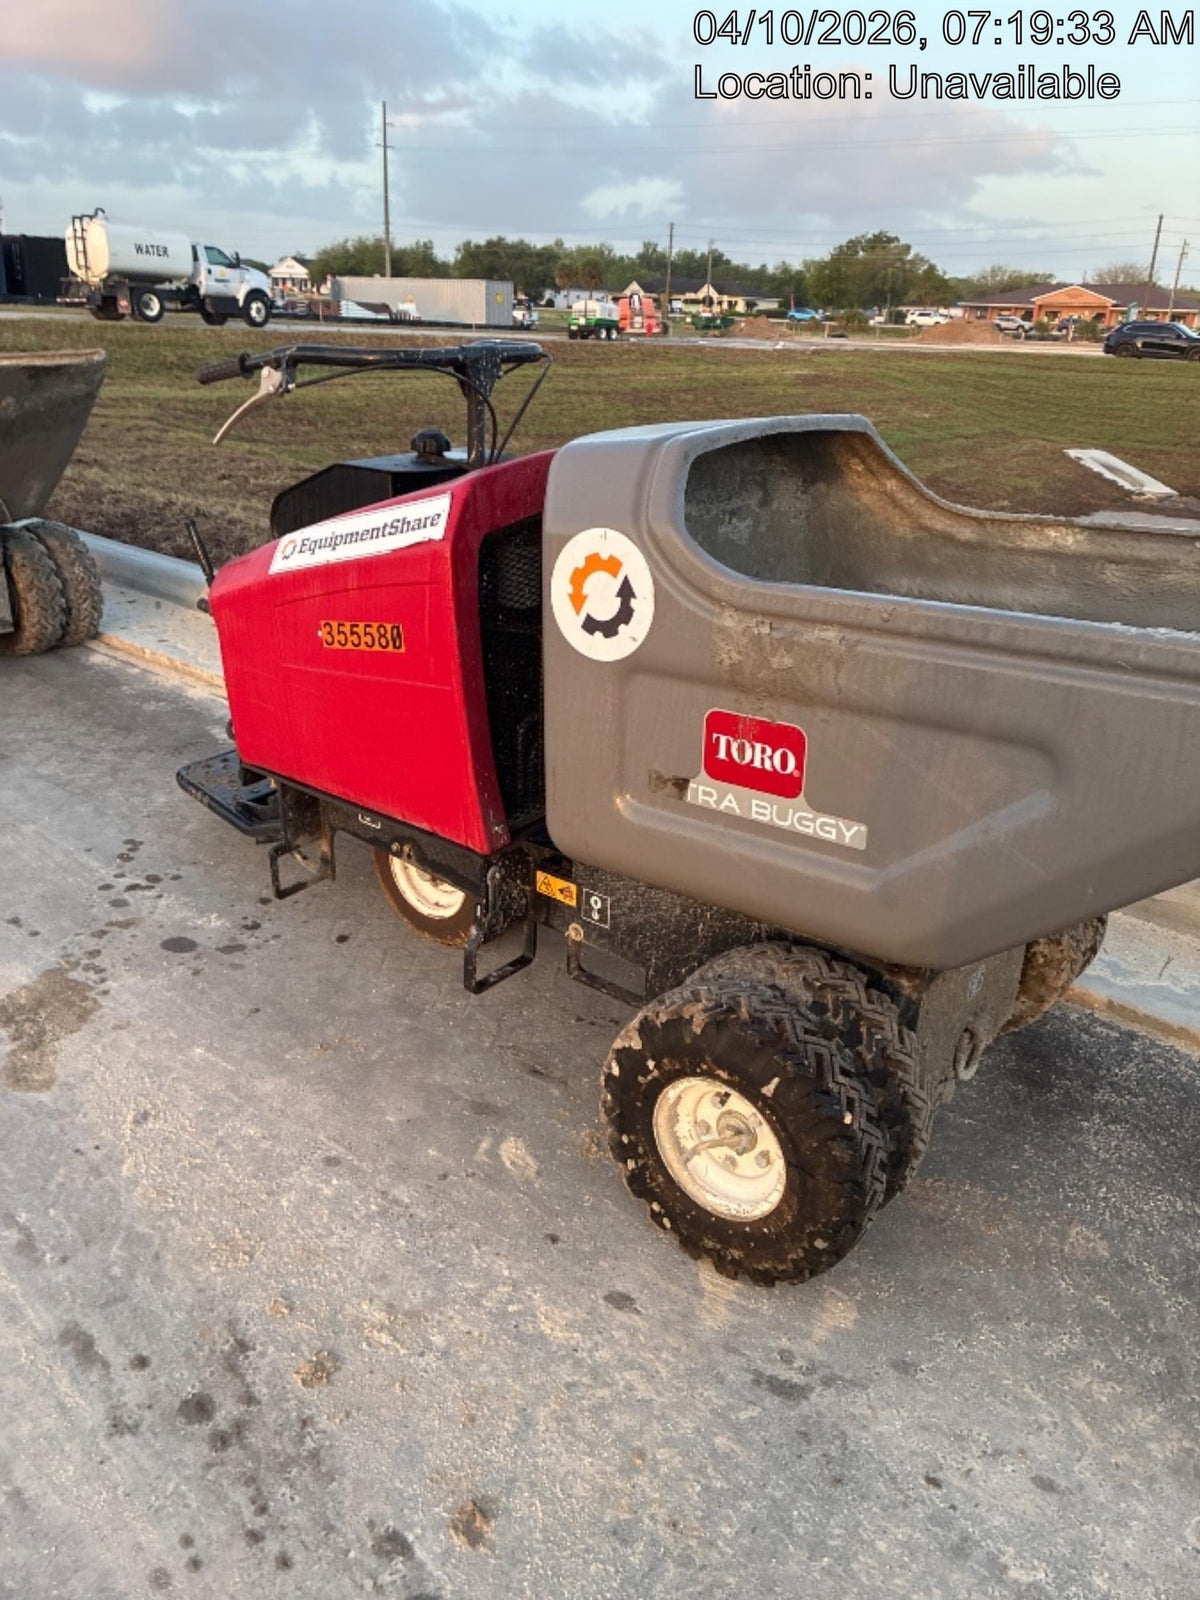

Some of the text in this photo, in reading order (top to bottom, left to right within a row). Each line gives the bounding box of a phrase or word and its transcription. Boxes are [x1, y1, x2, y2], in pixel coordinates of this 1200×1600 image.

[134, 243, 169, 257] WATER
[298, 512, 442, 555] EquipmentShare
[322, 621, 402, 650] 355580
[712, 733, 797, 775] TORO
[751, 799, 859, 844] BUGGY
